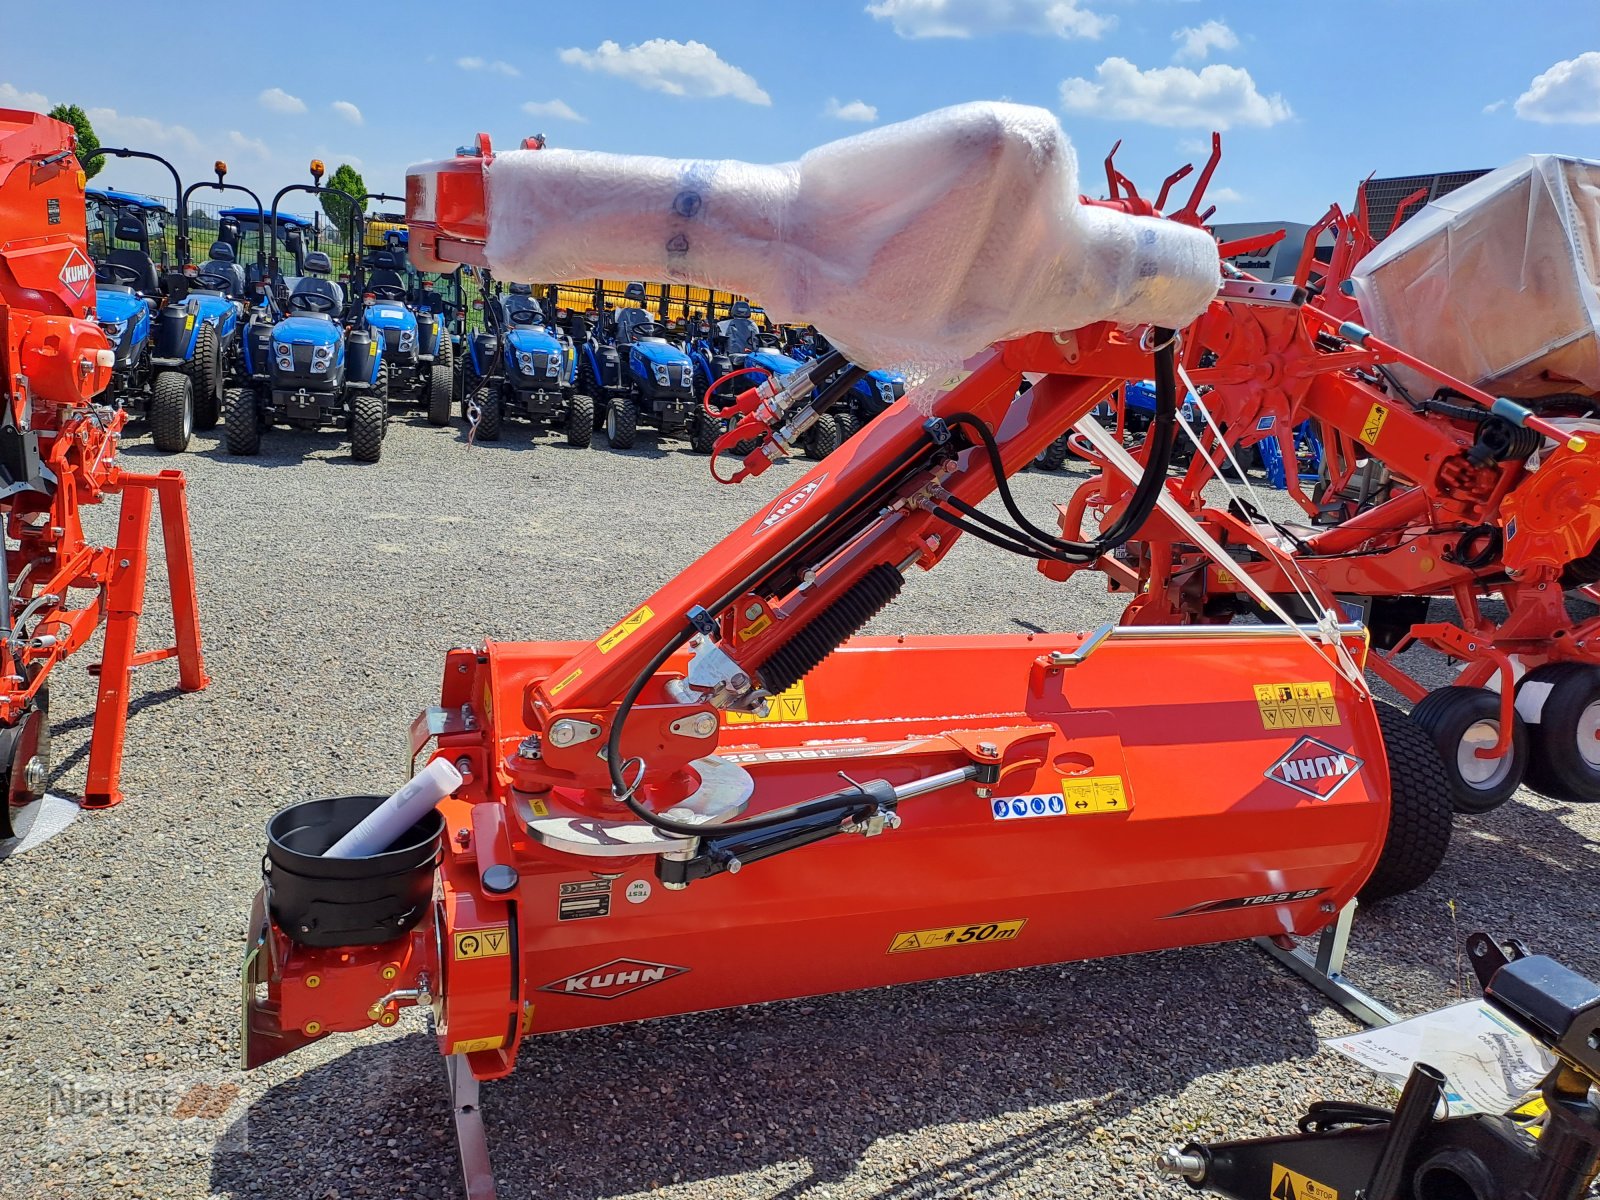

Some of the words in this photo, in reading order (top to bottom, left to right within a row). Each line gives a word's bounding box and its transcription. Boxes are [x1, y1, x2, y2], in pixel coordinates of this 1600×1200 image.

[65, 264, 89, 284] KUHN
[763, 482, 818, 526] KUHN
[721, 753, 757, 764] 22
[765, 749, 837, 761] TBES
[1281, 753, 1349, 782] KUHN
[1242, 892, 1290, 906] TBES
[1292, 889, 1319, 899] 22
[564, 966, 666, 993] KUHN
[1316, 1188, 1333, 1199] STOP
